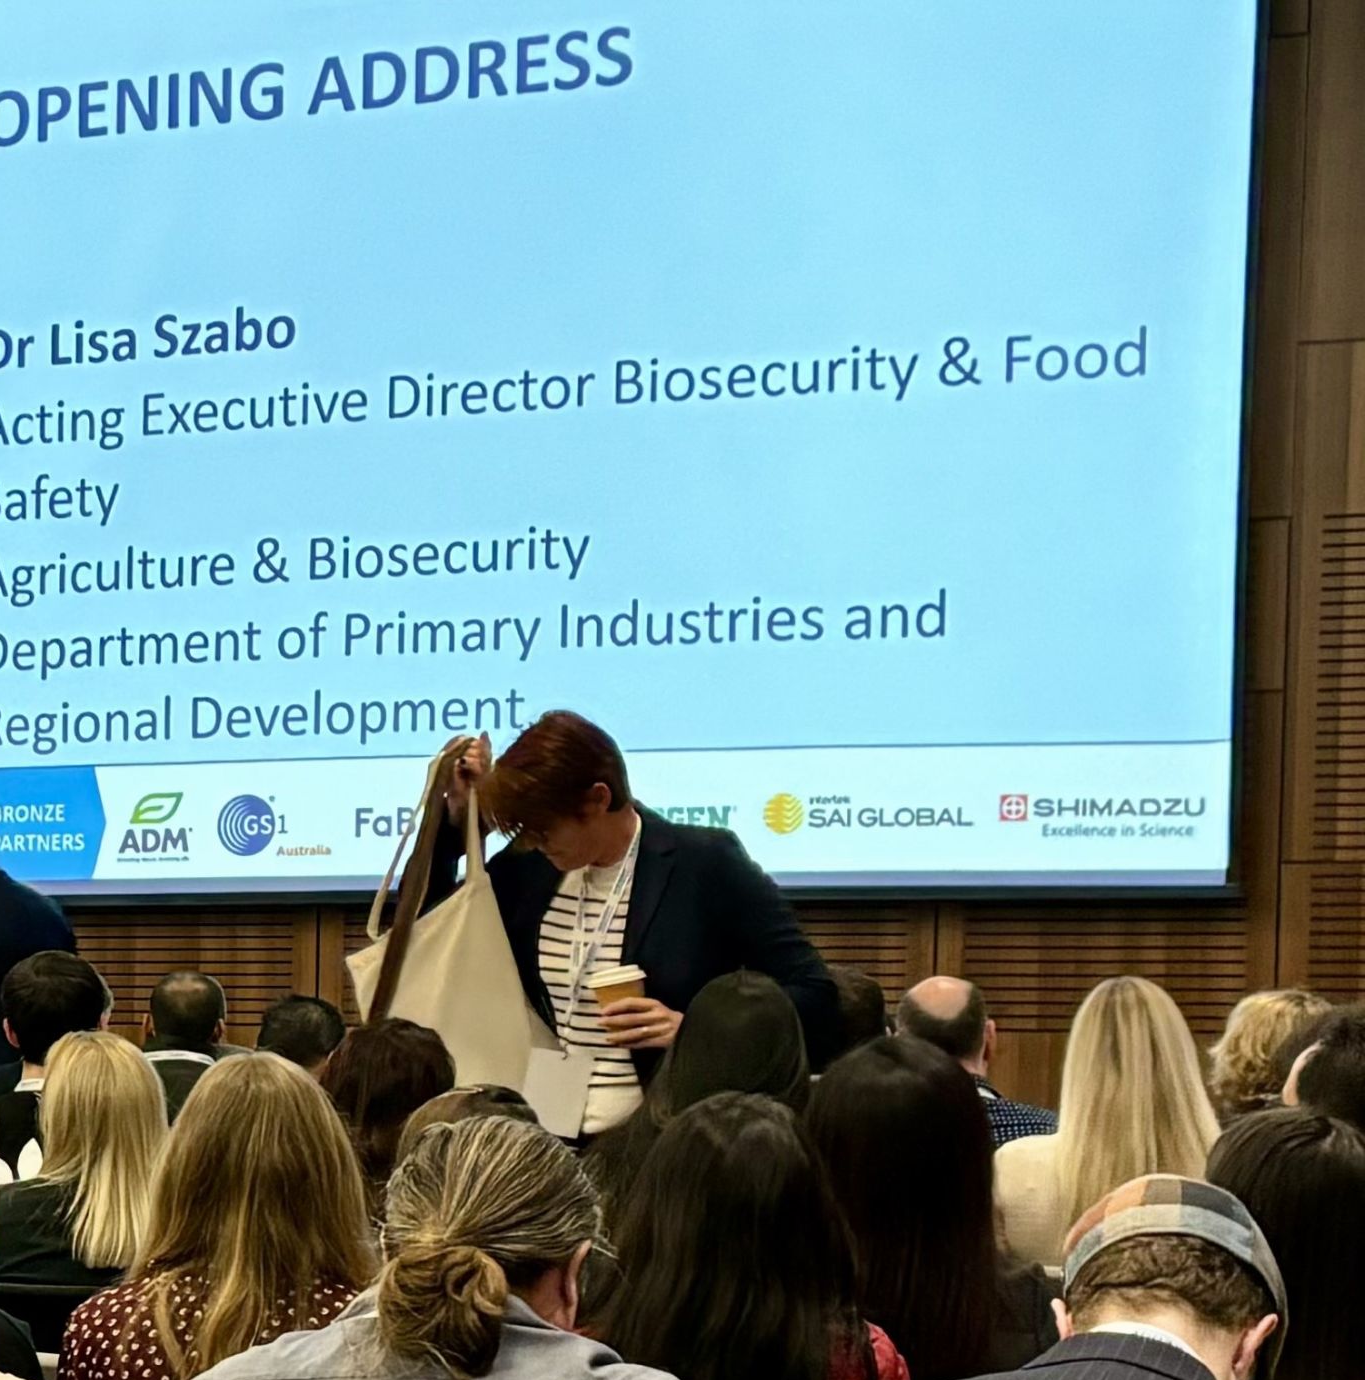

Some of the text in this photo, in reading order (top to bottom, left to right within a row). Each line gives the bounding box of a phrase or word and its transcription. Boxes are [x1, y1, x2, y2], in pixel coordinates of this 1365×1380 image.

[307, 26, 635, 116] ADDRESS
[50, 319, 137, 366] Lisa
[153, 307, 296, 359] Szabo
[142, 378, 369, 437] Executive
[386, 365, 595, 420] Director
[614, 344, 919, 405] Biosecurity
[938, 335, 981, 388] &
[1006, 325, 1149, 383] Food
[253, 537, 290, 582] &
[309, 525, 591, 582] Biosecurity
[278, 612, 328, 660] of
[345, 607, 540, 662] Primary
[560, 598, 824, 650] Industries
[844, 589, 947, 642] and
[191, 688, 525, 746] Development
[242, 815, 288, 836] GS1
[808, 806, 974, 828] SAI GLOBAL
[1033, 797, 1206, 817] SHIMADZU
[119, 828, 189, 854] ADM
[1041, 823, 1194, 837] Excellence in Science
[276, 845, 332, 857] Australia
